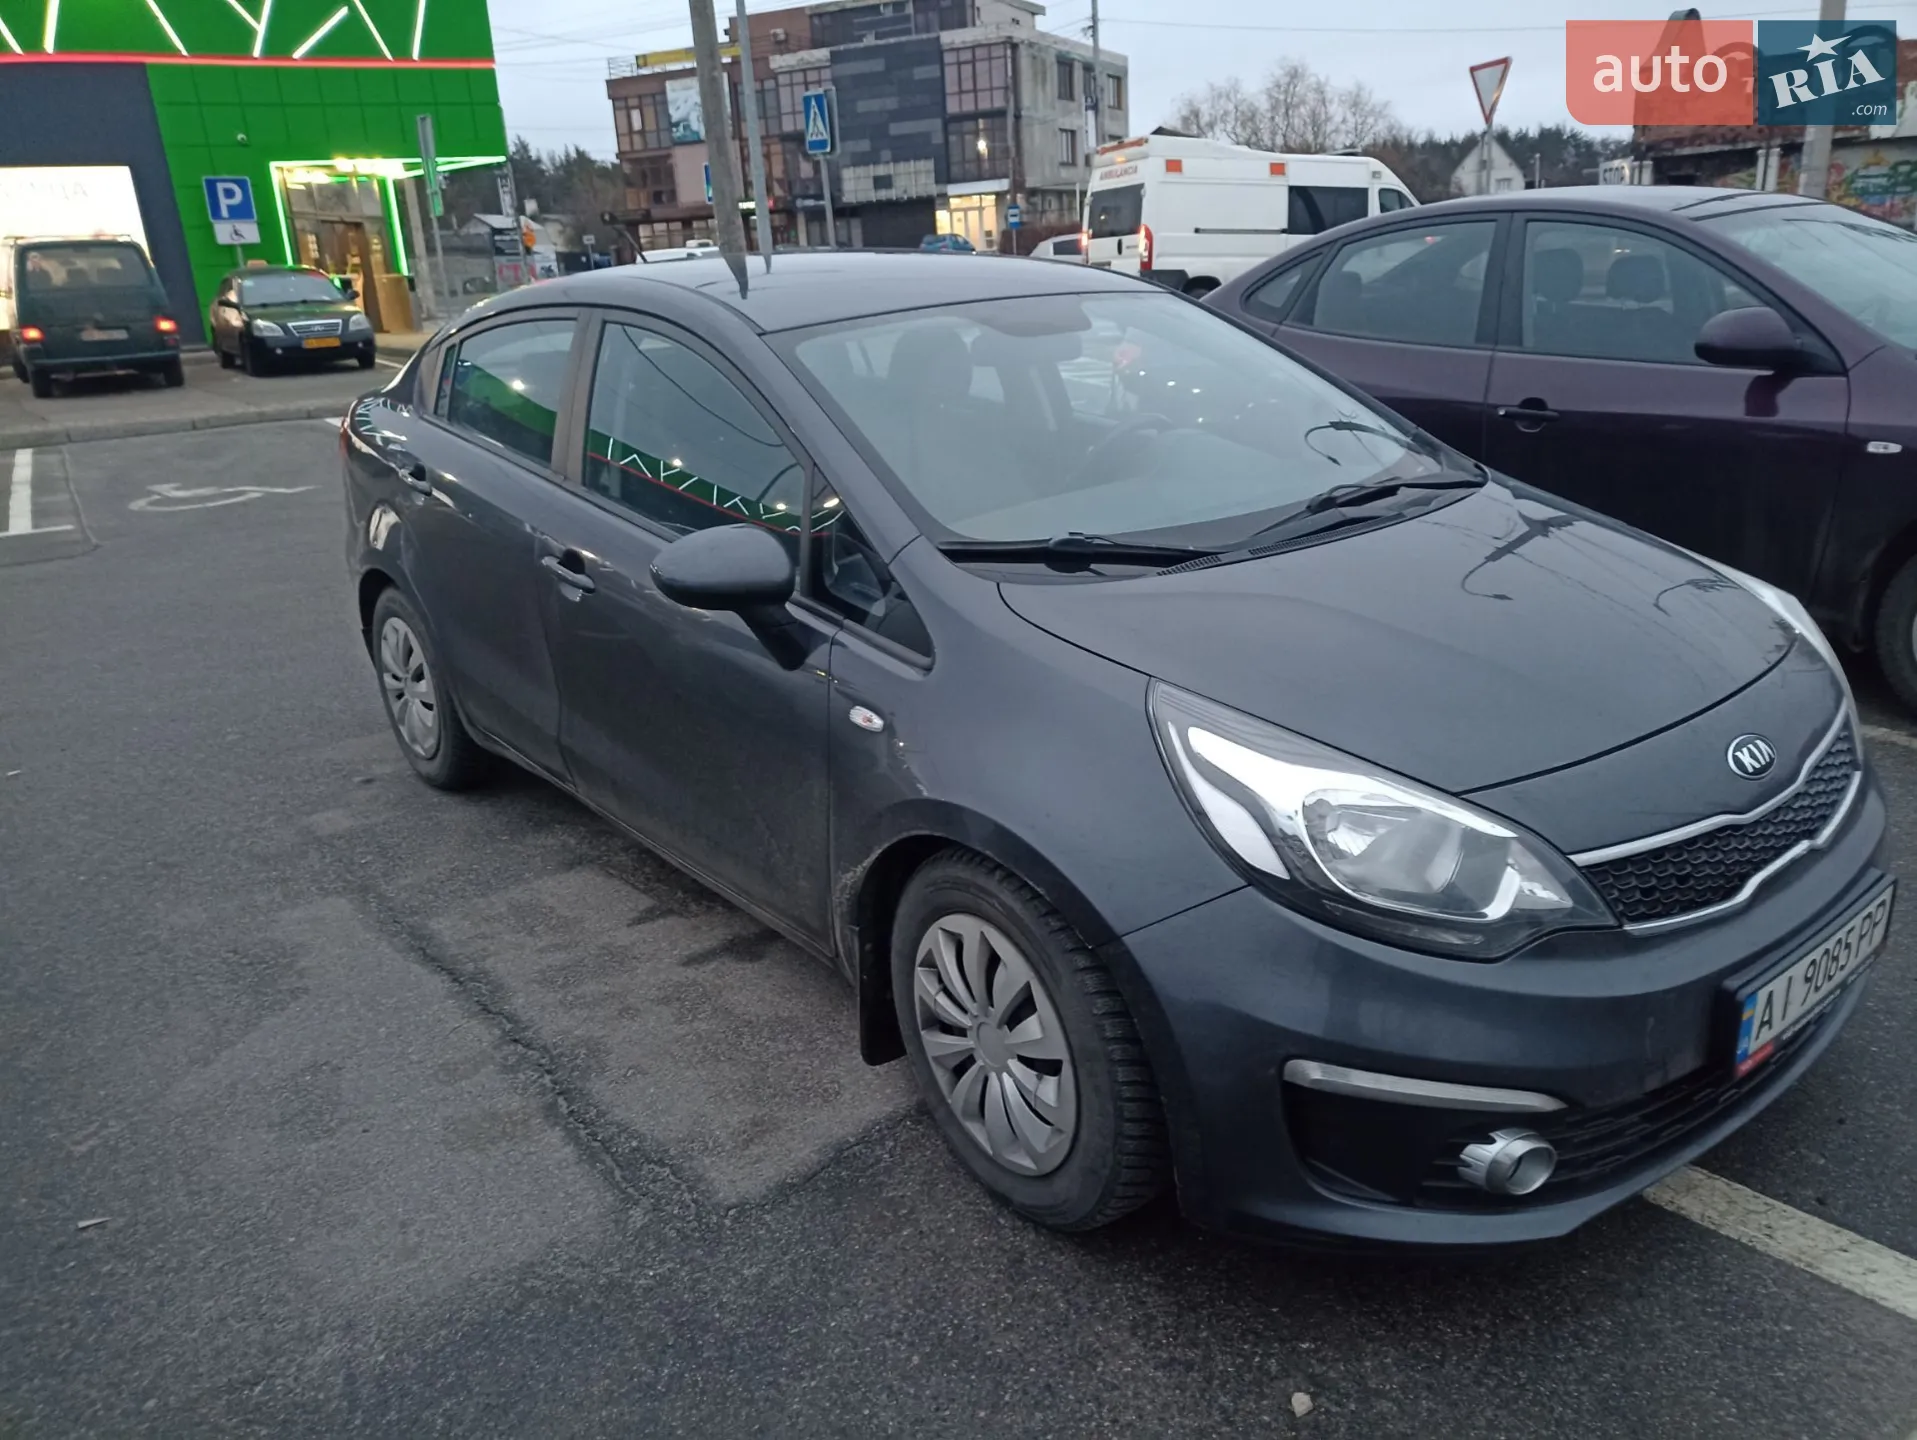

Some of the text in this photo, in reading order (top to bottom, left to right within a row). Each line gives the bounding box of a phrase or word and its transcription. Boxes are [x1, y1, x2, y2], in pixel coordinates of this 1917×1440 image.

[216, 182, 243, 218] P
[1734, 740, 1775, 773] KIA
[1801, 926, 1856, 1006] 9085
[1856, 899, 1887, 959] PP
